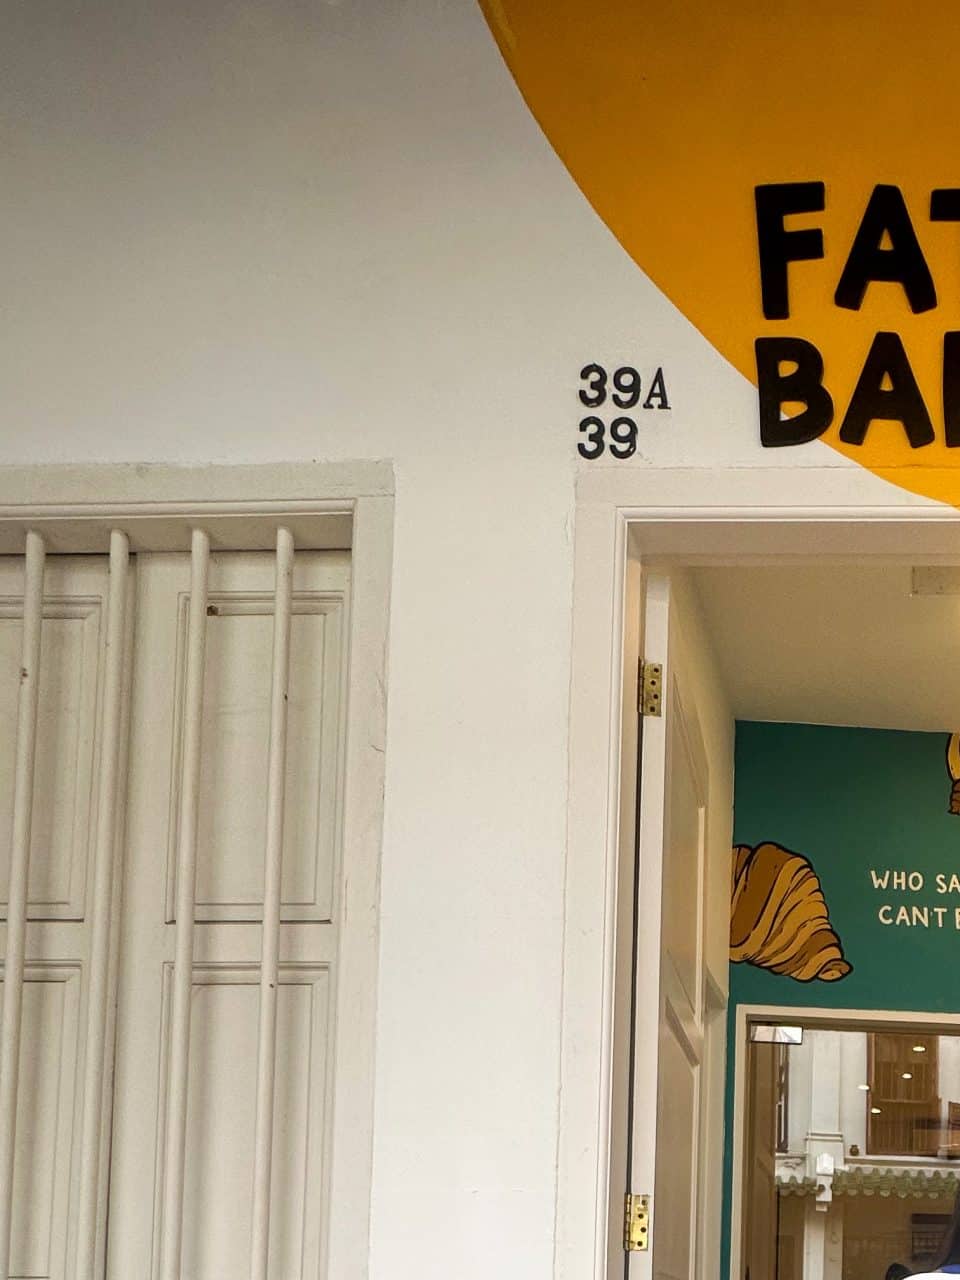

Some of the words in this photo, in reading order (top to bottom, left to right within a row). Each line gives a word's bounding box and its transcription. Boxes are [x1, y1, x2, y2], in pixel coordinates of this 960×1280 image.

[578, 363, 672, 410] 39A
[577, 416, 639, 460] 39
[870, 869, 924, 892] WHO
[878, 905, 947, 928] CAN'T
